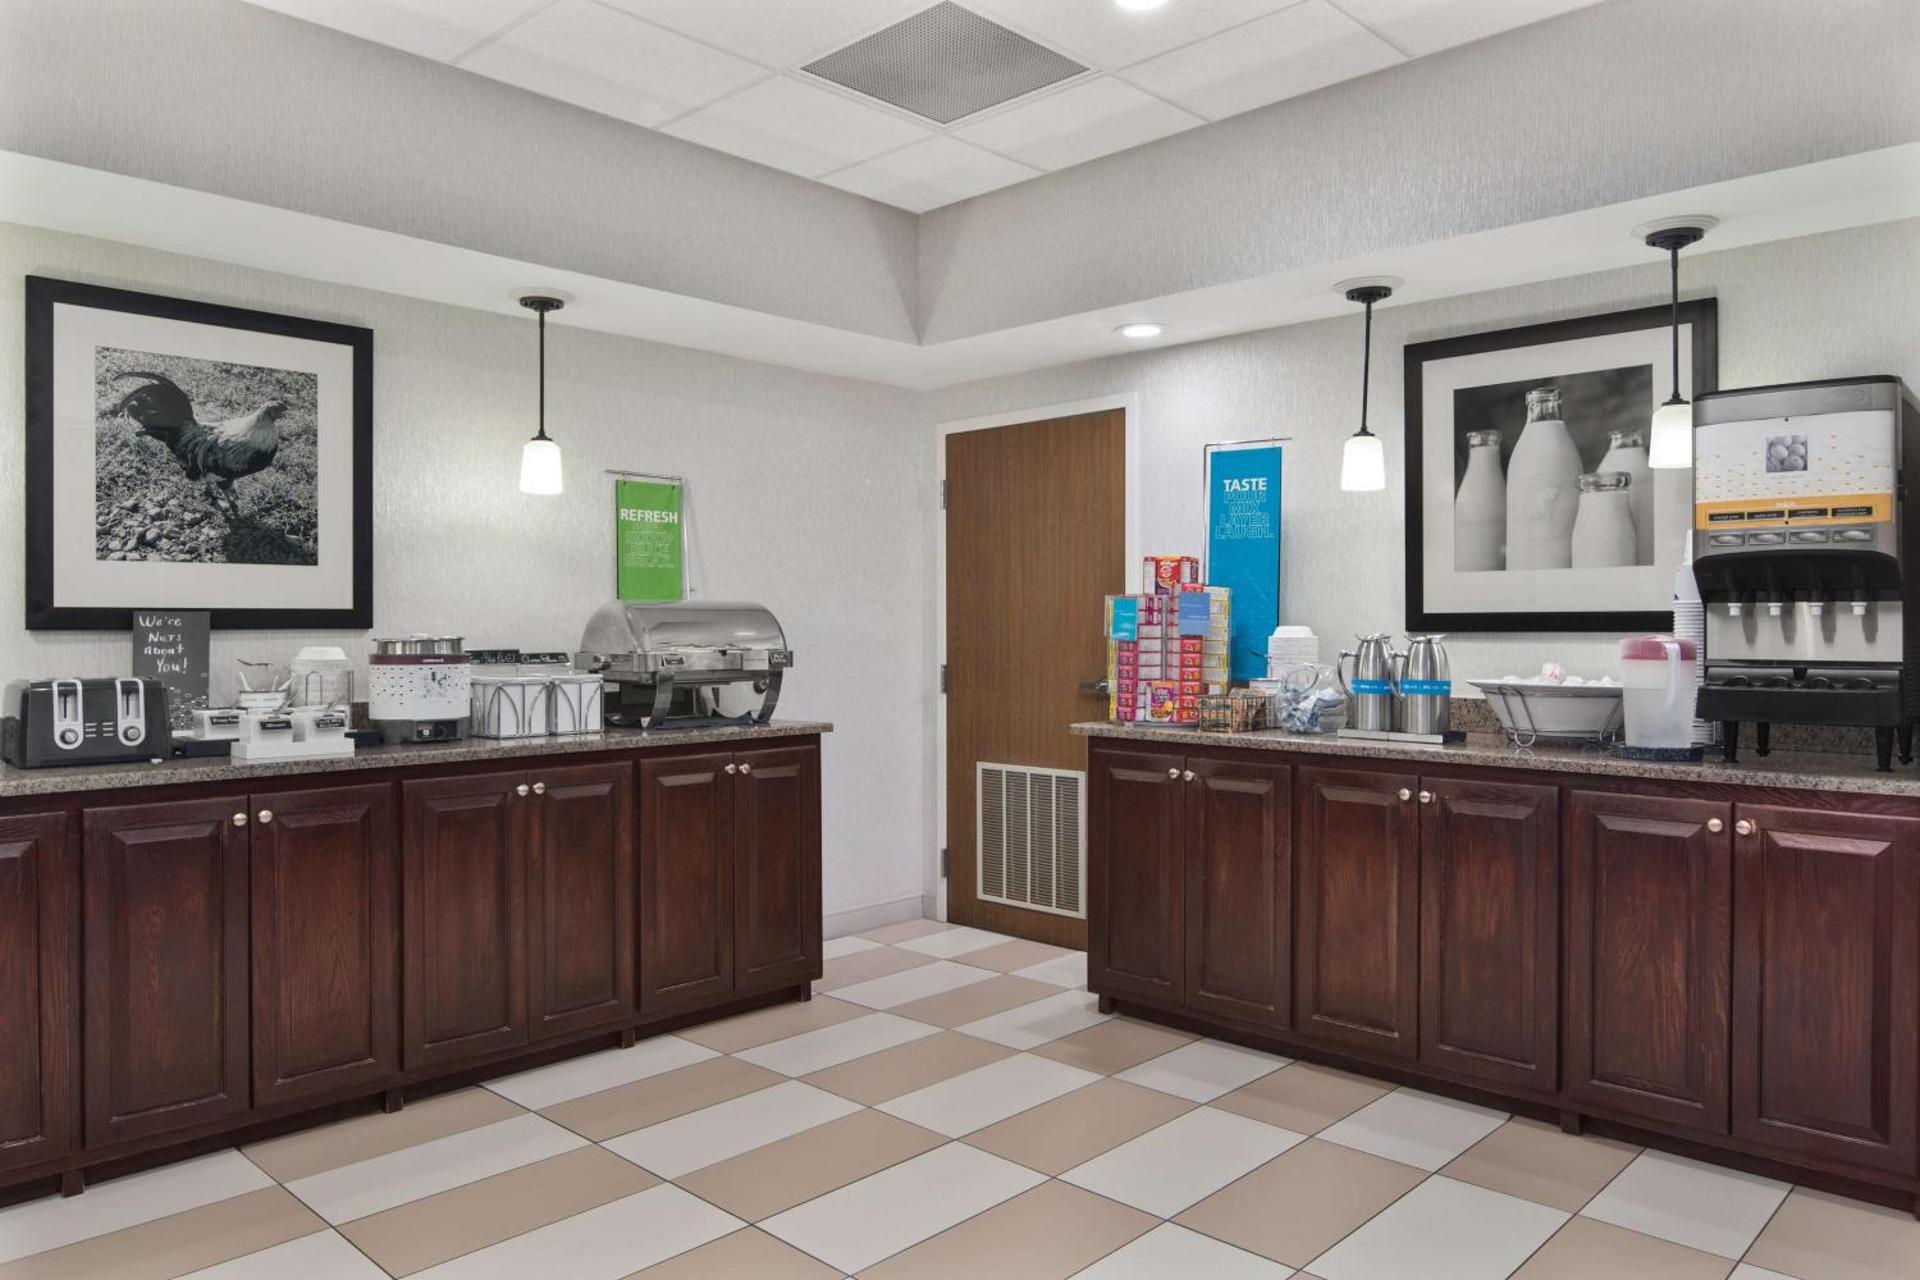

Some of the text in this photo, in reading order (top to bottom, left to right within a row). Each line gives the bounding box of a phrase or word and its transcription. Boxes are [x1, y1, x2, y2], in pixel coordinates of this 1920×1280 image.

[1223, 477, 1268, 492] TASTE
[620, 508, 678, 524] REFRESH
[1219, 513, 1270, 527] LAYER
[139, 615, 183, 628] We're
[156, 655, 188, 674] You!
